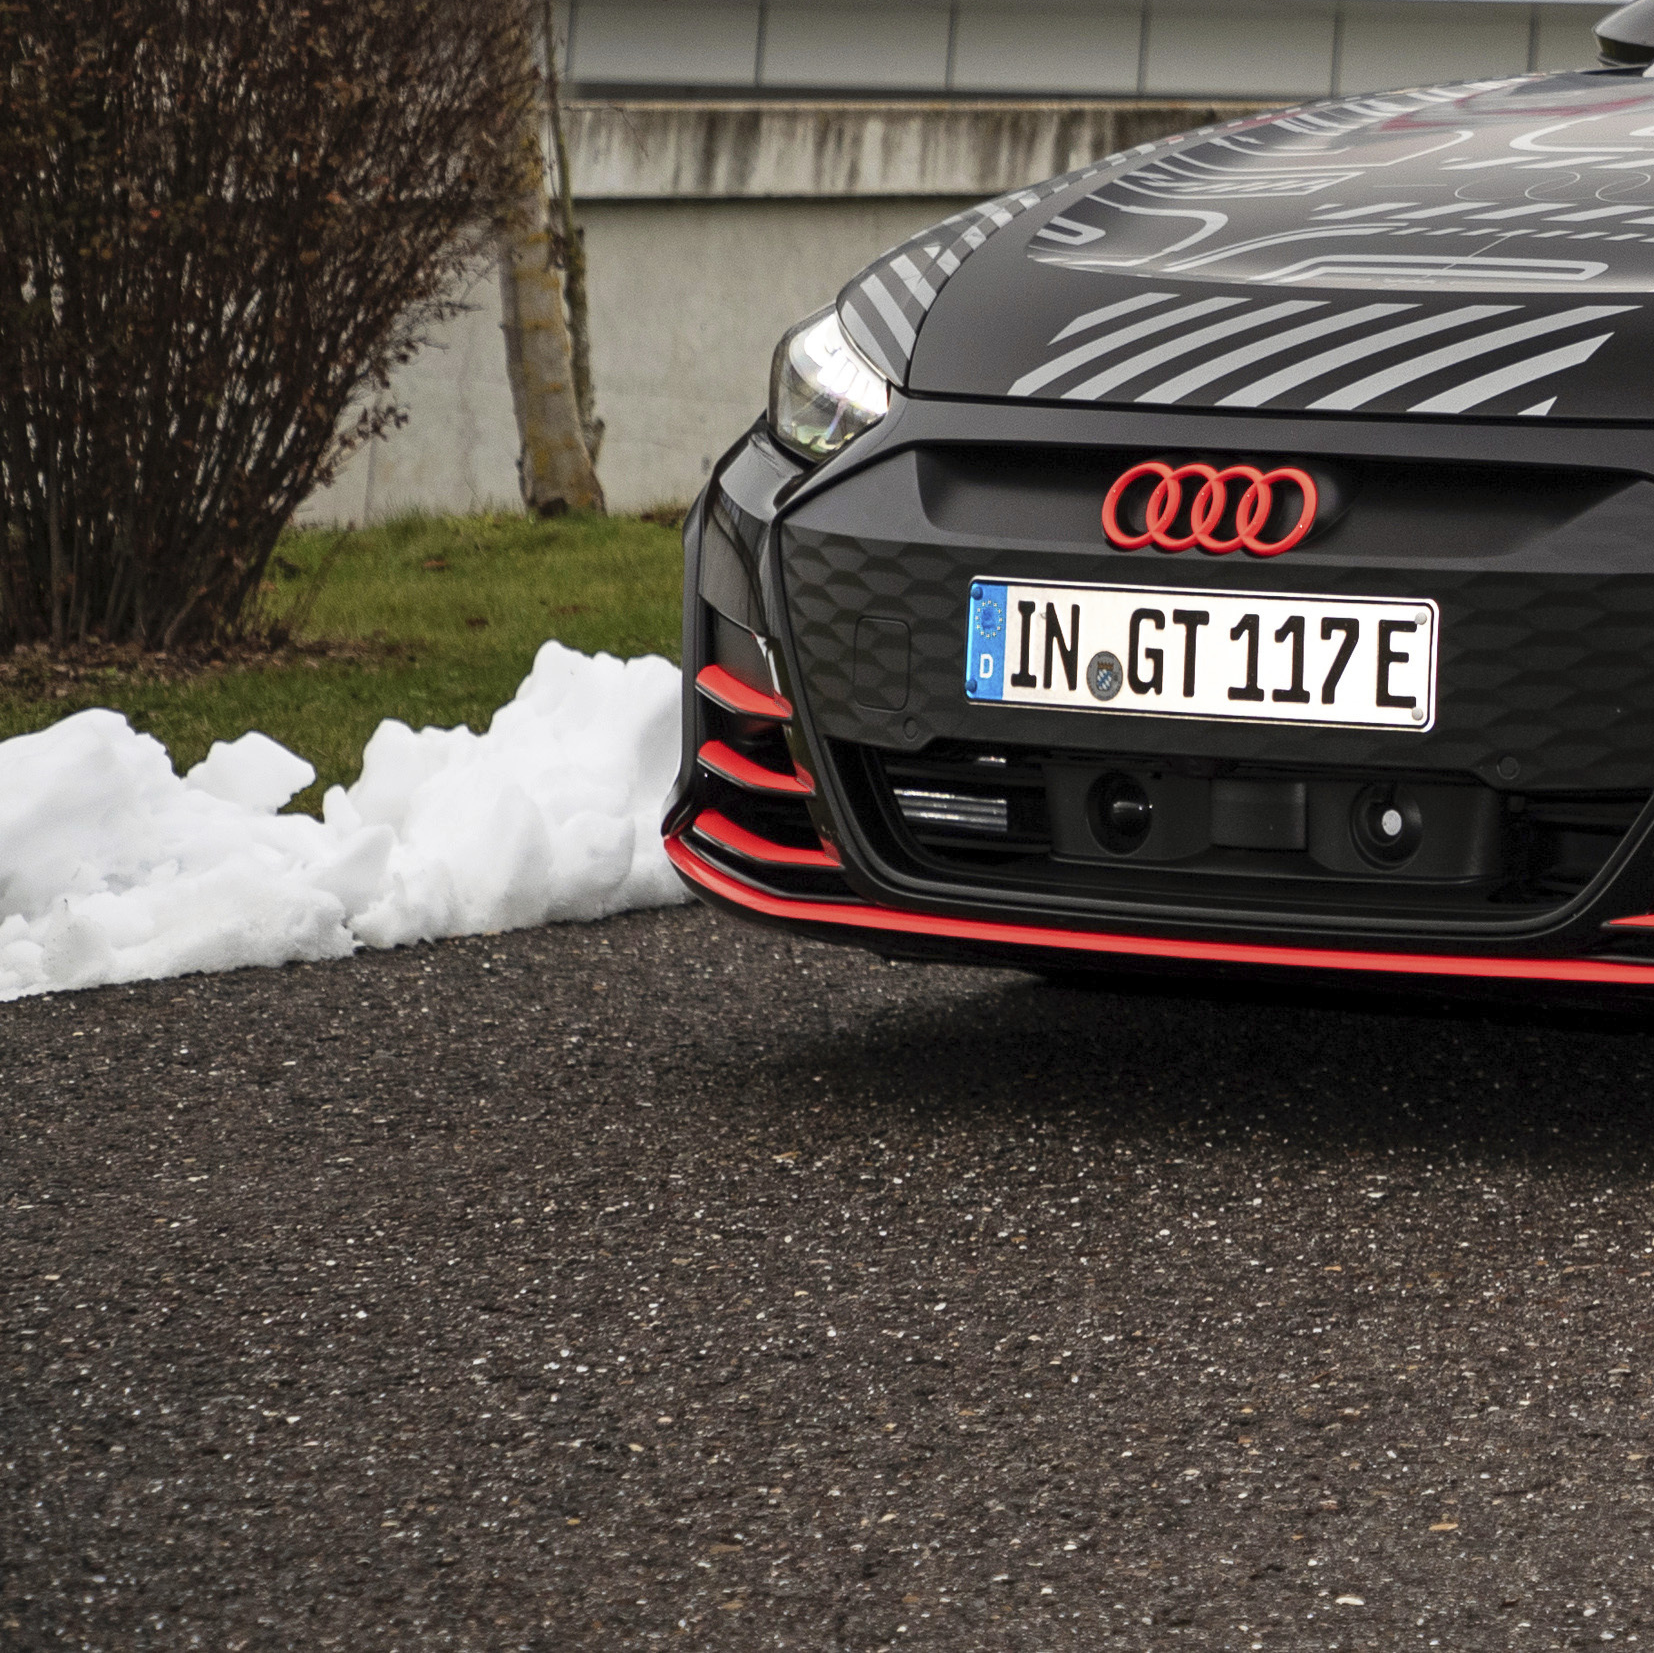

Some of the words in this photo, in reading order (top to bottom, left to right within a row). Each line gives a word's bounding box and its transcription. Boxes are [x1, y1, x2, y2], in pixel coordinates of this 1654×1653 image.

[979, 653, 994, 679] D
[1010, 600, 1081, 691] IN
[1127, 608, 1210, 698] GT
